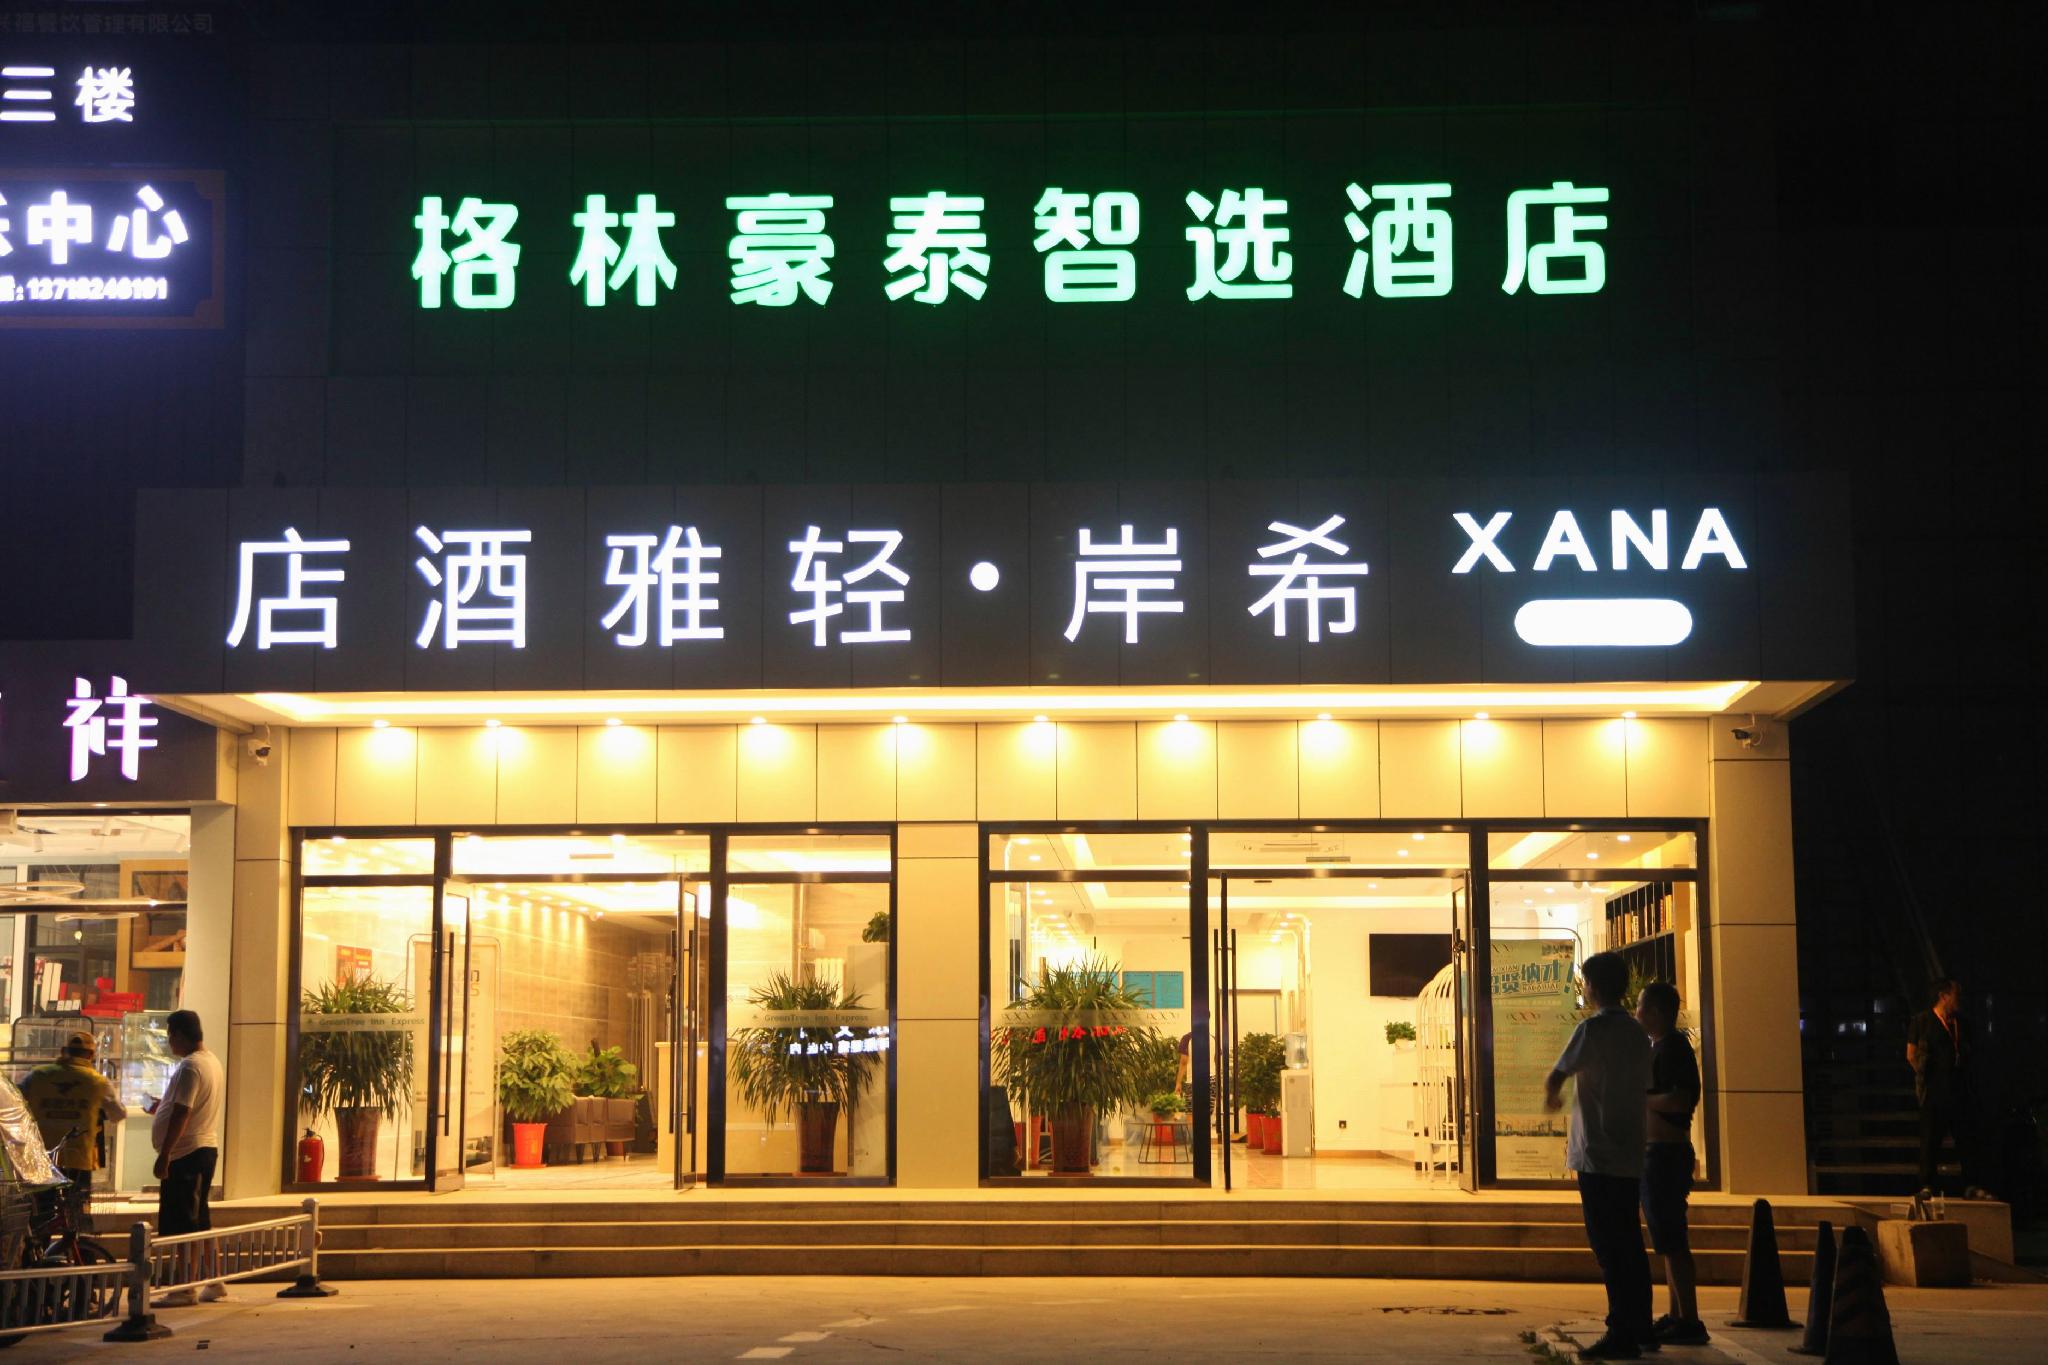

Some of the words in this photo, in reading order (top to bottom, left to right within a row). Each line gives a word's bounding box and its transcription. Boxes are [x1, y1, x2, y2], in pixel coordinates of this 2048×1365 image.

[0, 66, 135, 122] 三楼
[0, 185, 189, 265] 中心
[410, 180, 1611, 310] 格林豪泰智选酒店
[1452, 507, 1748, 575] XANA
[62, 675, 159, 782] 祥
[391, 1016, 425, 1027] Express
